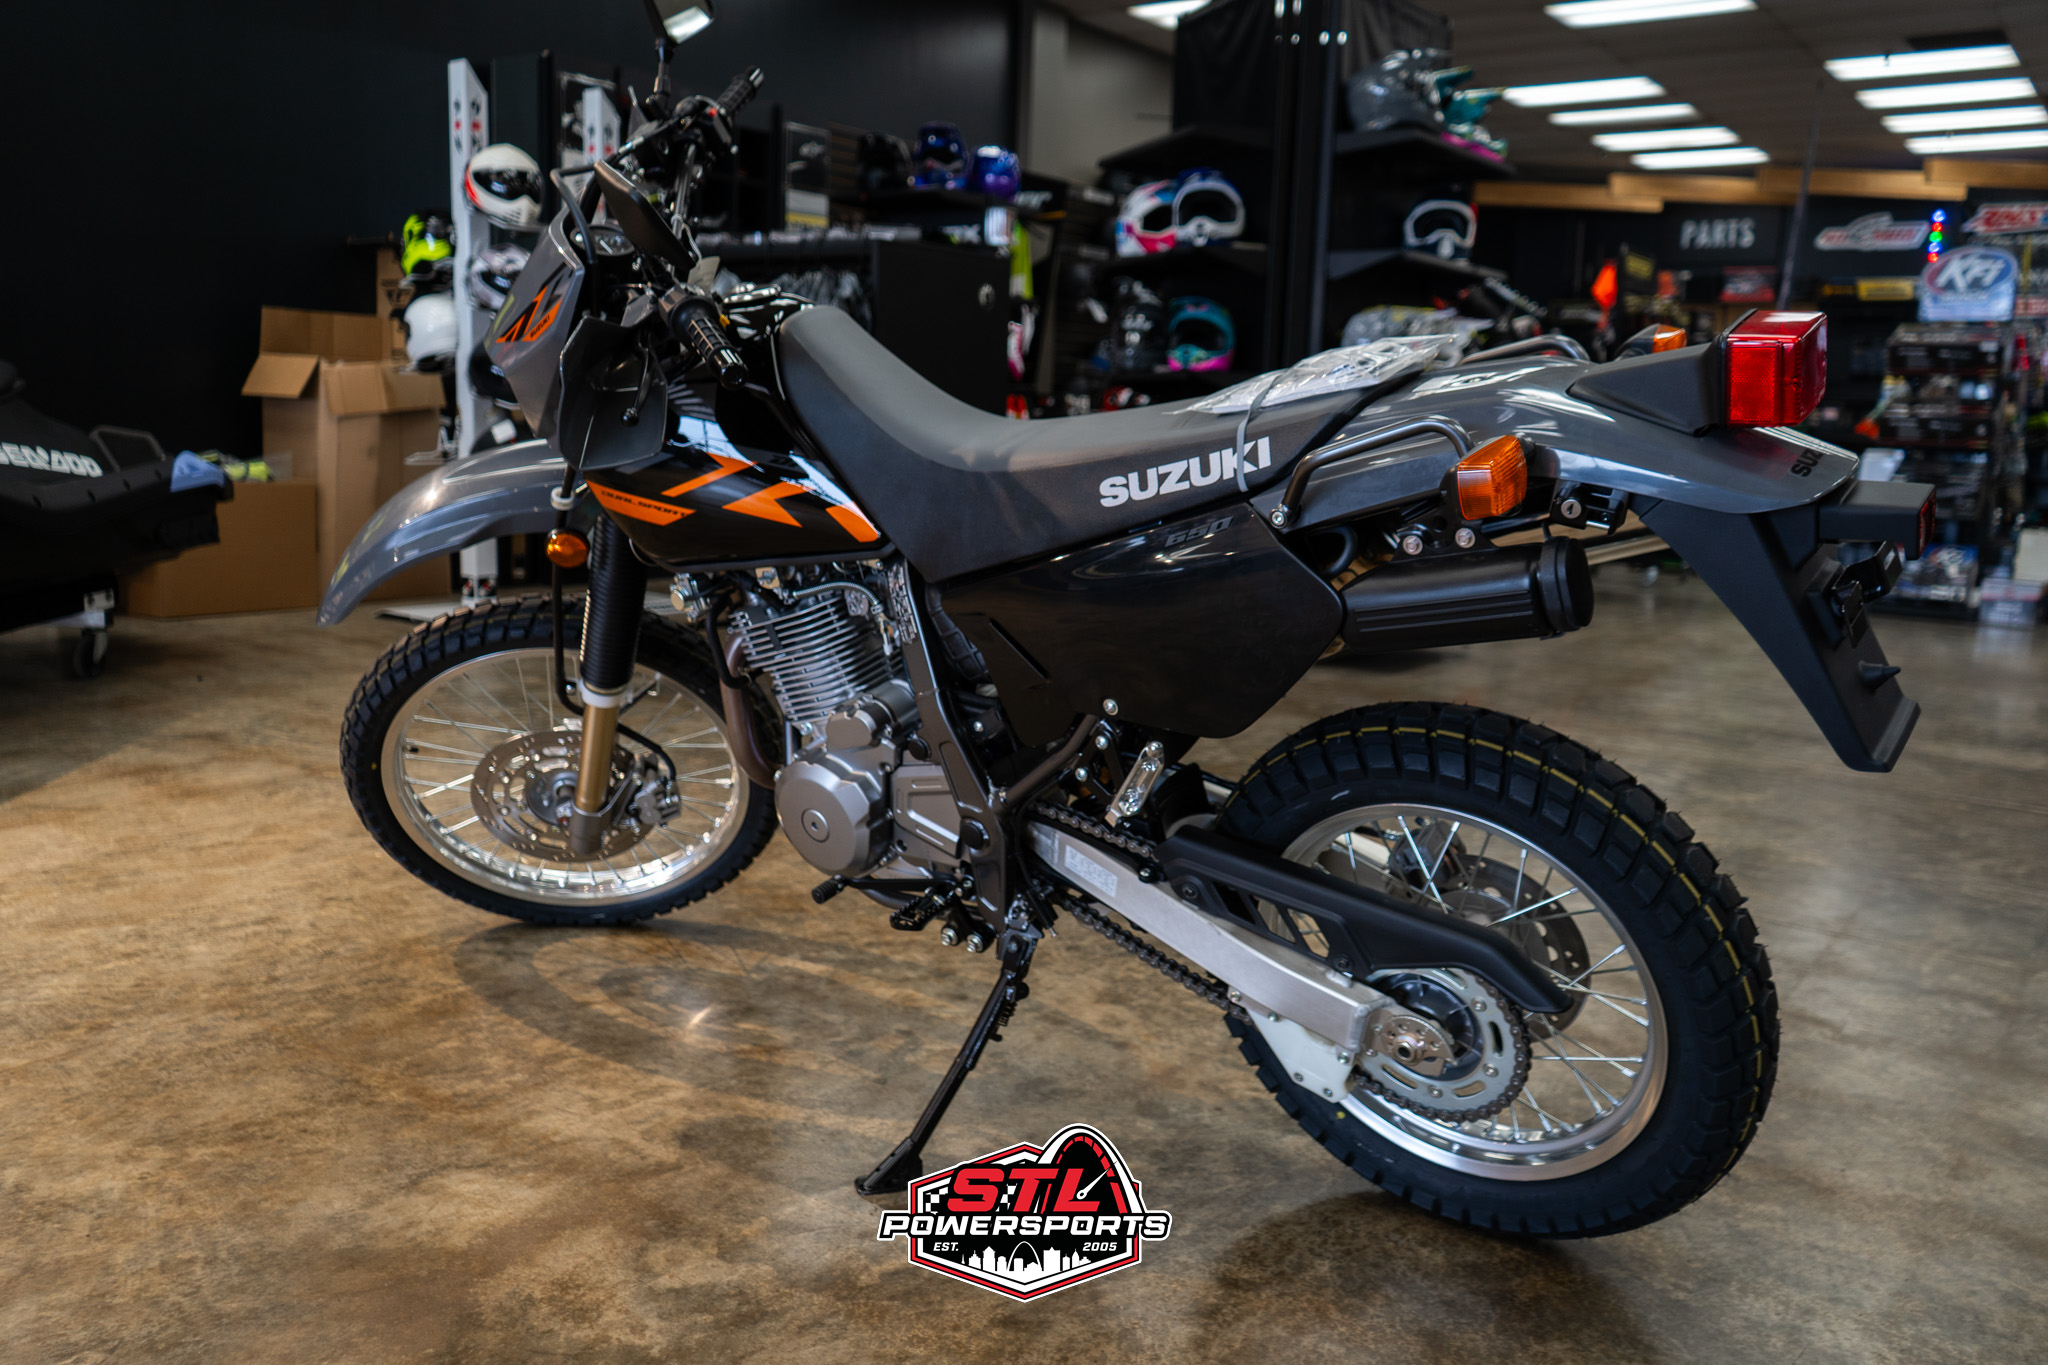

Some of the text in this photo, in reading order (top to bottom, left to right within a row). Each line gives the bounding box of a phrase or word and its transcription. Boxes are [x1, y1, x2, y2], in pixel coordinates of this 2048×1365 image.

[1680, 217, 1756, 249] PARTS
[1099, 436, 1272, 508] SUZUKI
[1164, 516, 1234, 548] 650
